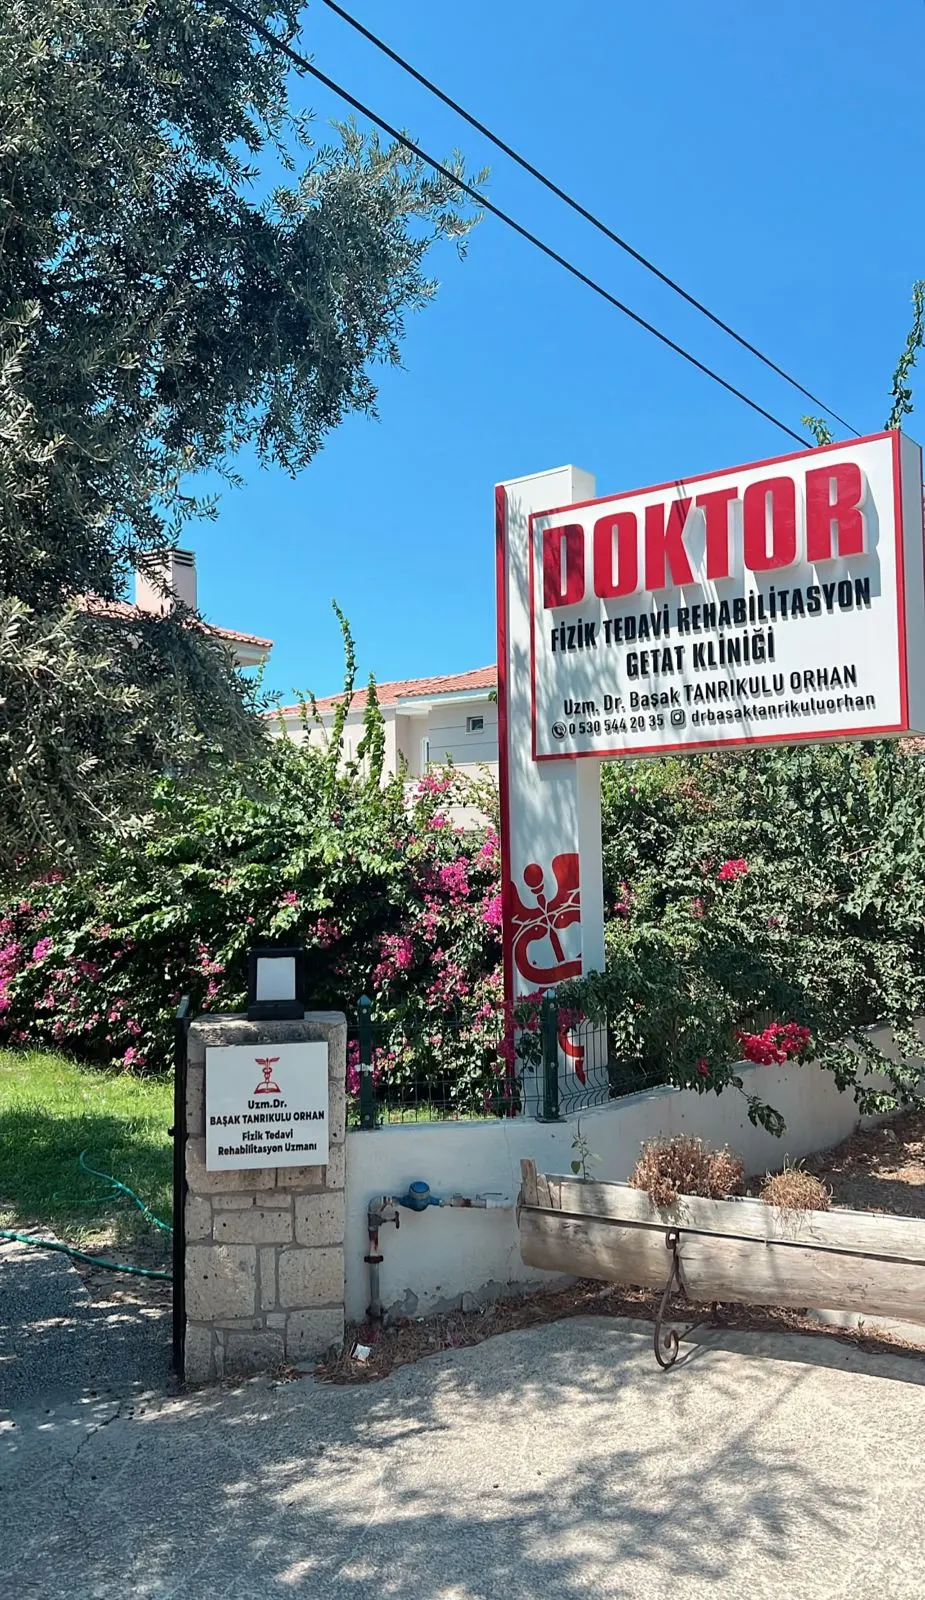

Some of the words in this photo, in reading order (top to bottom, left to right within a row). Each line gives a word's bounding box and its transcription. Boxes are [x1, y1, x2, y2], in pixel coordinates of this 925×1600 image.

[542, 462, 864, 609] DOKTOR
[551, 617, 596, 651] FİZİK
[603, 603, 669, 644] TEDAVİ
[677, 577, 871, 632] REHABİLİTASYON
[626, 647, 685, 679] GETAT
[693, 626, 775, 669] KLİNİĞİ
[564, 699, 599, 716] Uzm.
[603, 694, 625, 711] Dr.
[630, 687, 679, 708] Başak
[683, 673, 784, 701] TANRIKULU
[790, 664, 857, 690] ORHAN
[569, 723, 576, 735] 0
[579, 720, 600, 734] 530
[604, 718, 627, 731] 544
[630, 715, 645, 729] 20
[649, 713, 664, 727] 35
[691, 694, 876, 723] drbasaktanrikuluorhan
[210, 1115, 240, 1127] BAŞAK
[242, 1112, 292, 1124] TANRIKULU
[293, 1110, 325, 1121] ORHAN
[248, 1099, 287, 1109] Uzm.Dr.
[218, 1143, 283, 1156] Rehabilitasyon
[285, 1142, 317, 1152] Uzmanı
[242, 1130, 263, 1141] Fizik
[265, 1128, 294, 1140] Tedavi
